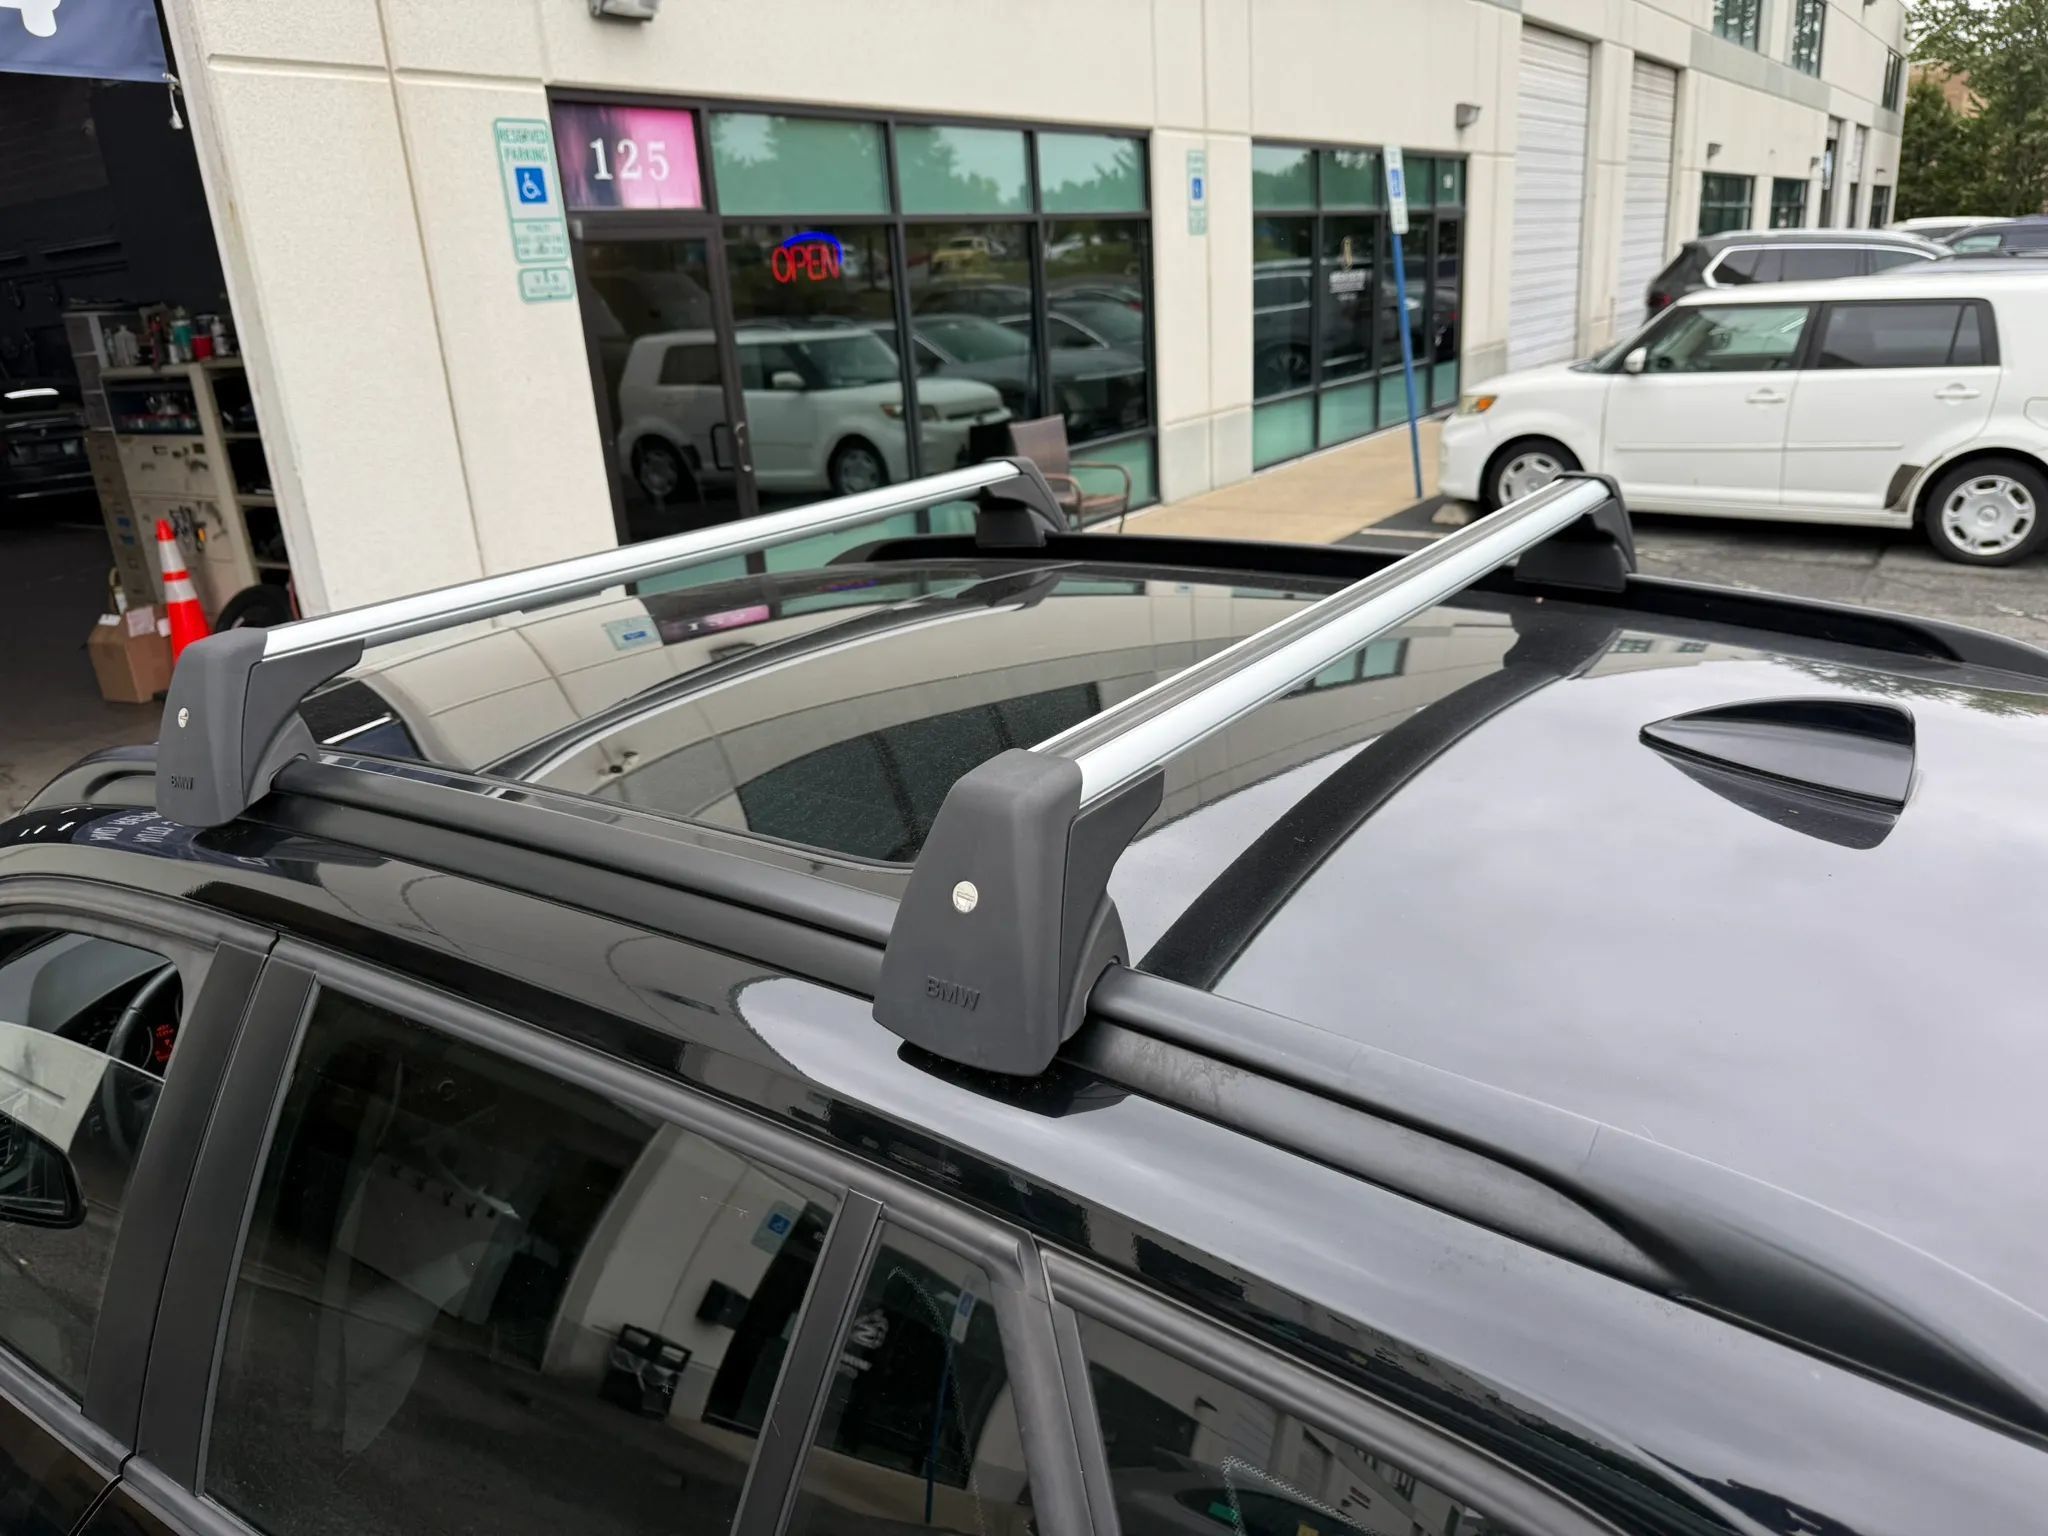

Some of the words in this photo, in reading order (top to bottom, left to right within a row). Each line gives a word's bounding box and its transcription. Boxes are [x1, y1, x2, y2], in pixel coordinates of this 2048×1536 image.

[503, 146, 548, 162] PARKING
[589, 137, 669, 180] 125
[771, 243, 841, 283] OPEN
[171, 775, 194, 790] BMW
[927, 976, 981, 1012] BMW
